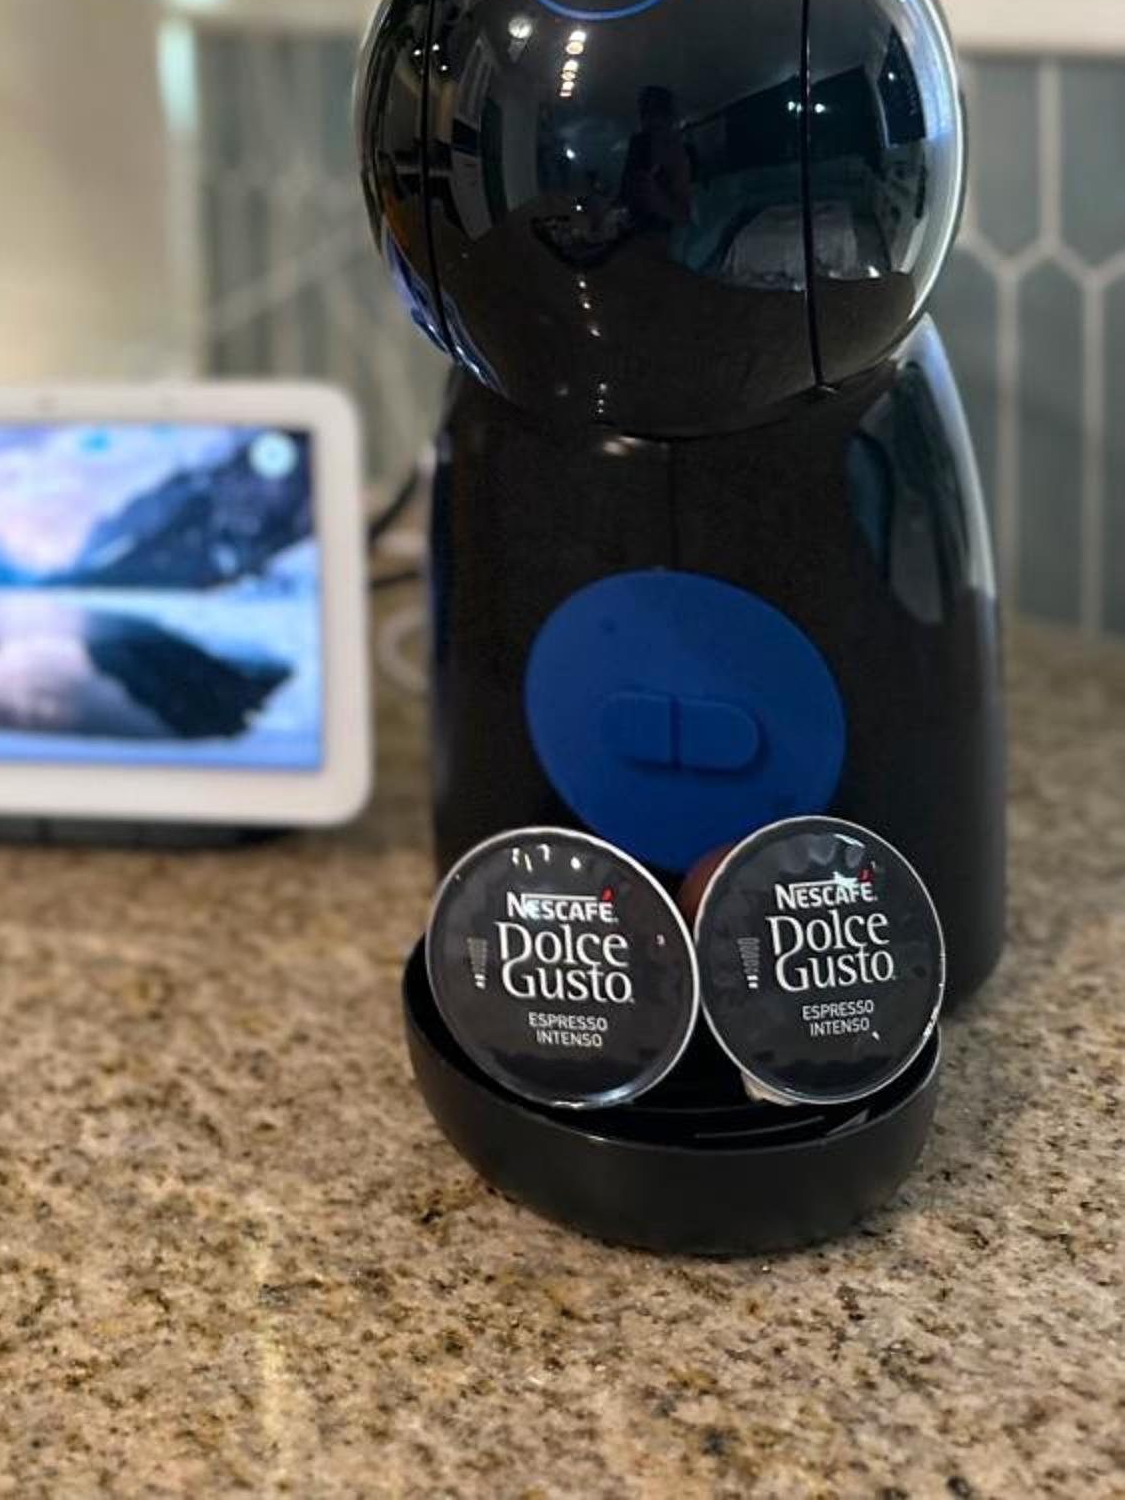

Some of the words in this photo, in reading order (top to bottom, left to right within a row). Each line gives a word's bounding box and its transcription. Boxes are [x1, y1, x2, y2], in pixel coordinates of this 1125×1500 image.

[494, 921, 629, 967] Dolce
[766, 910, 890, 956] Dolce
[502, 958, 631, 1003] Gusto
[775, 946, 893, 992] Gusto
[528, 1011, 608, 1031] ESPRESSO
[802, 999, 875, 1021] ESPRESSO
[536, 1030, 603, 1047] INTENSO
[810, 1017, 870, 1037] INTENSO
